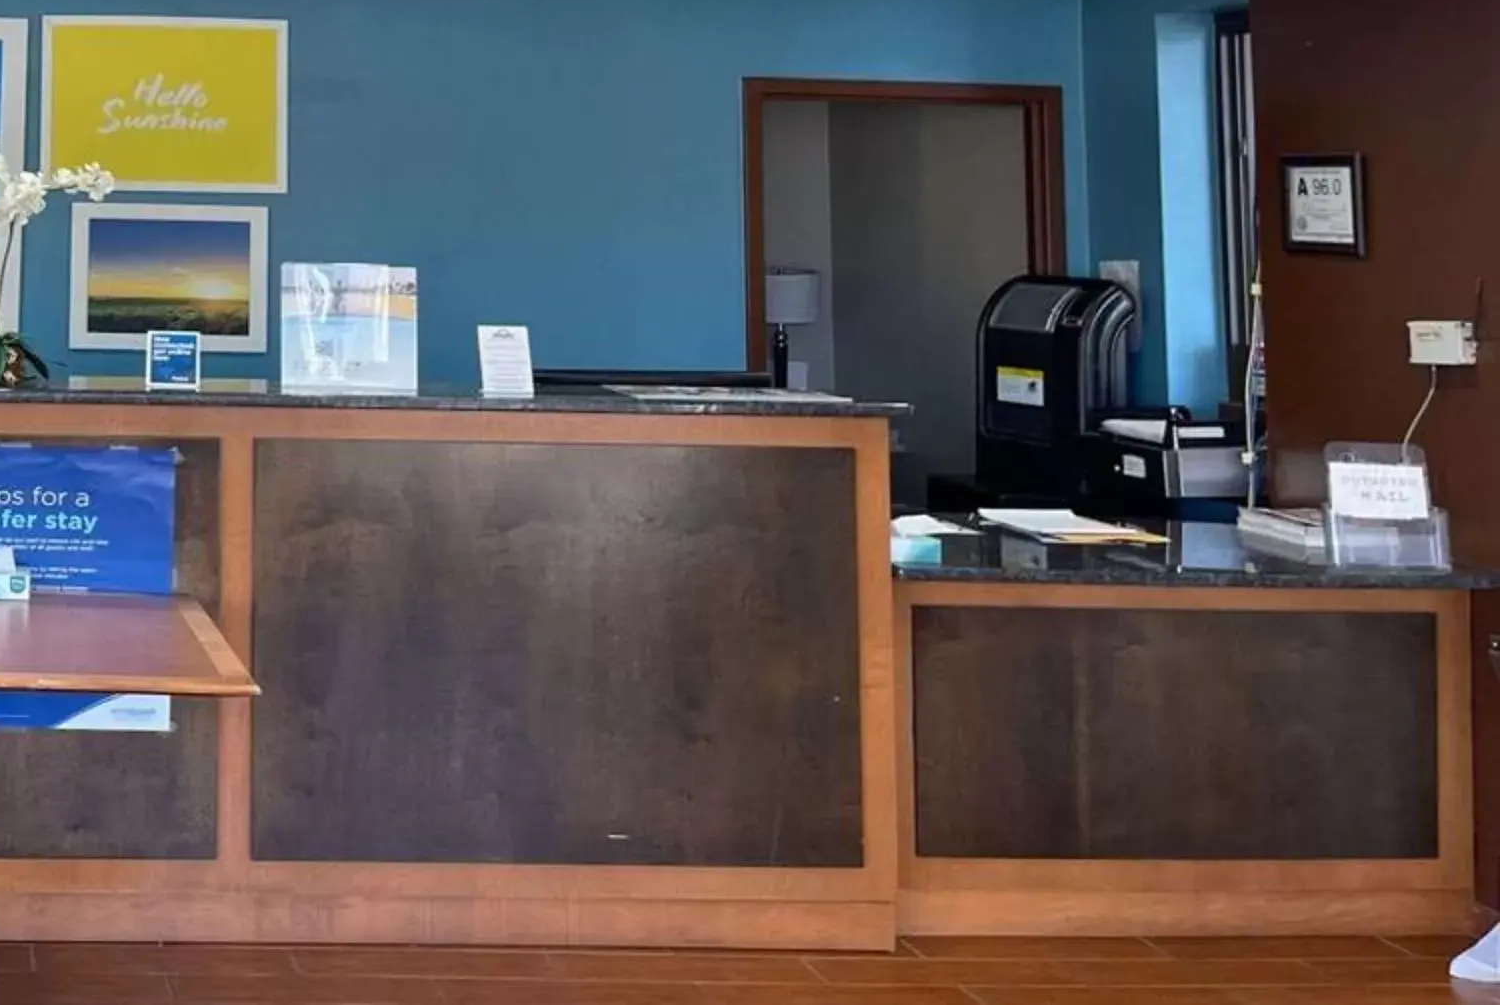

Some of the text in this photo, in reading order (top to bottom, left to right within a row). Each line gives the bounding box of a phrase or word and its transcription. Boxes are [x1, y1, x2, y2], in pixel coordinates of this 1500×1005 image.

[134, 72, 209, 108] Hello
[97, 97, 229, 134] Sunshine
[1297, 177, 1309, 196] A
[33, 486, 67, 506] for
[75, 491, 90, 508] a
[45, 511, 98, 533] stay
